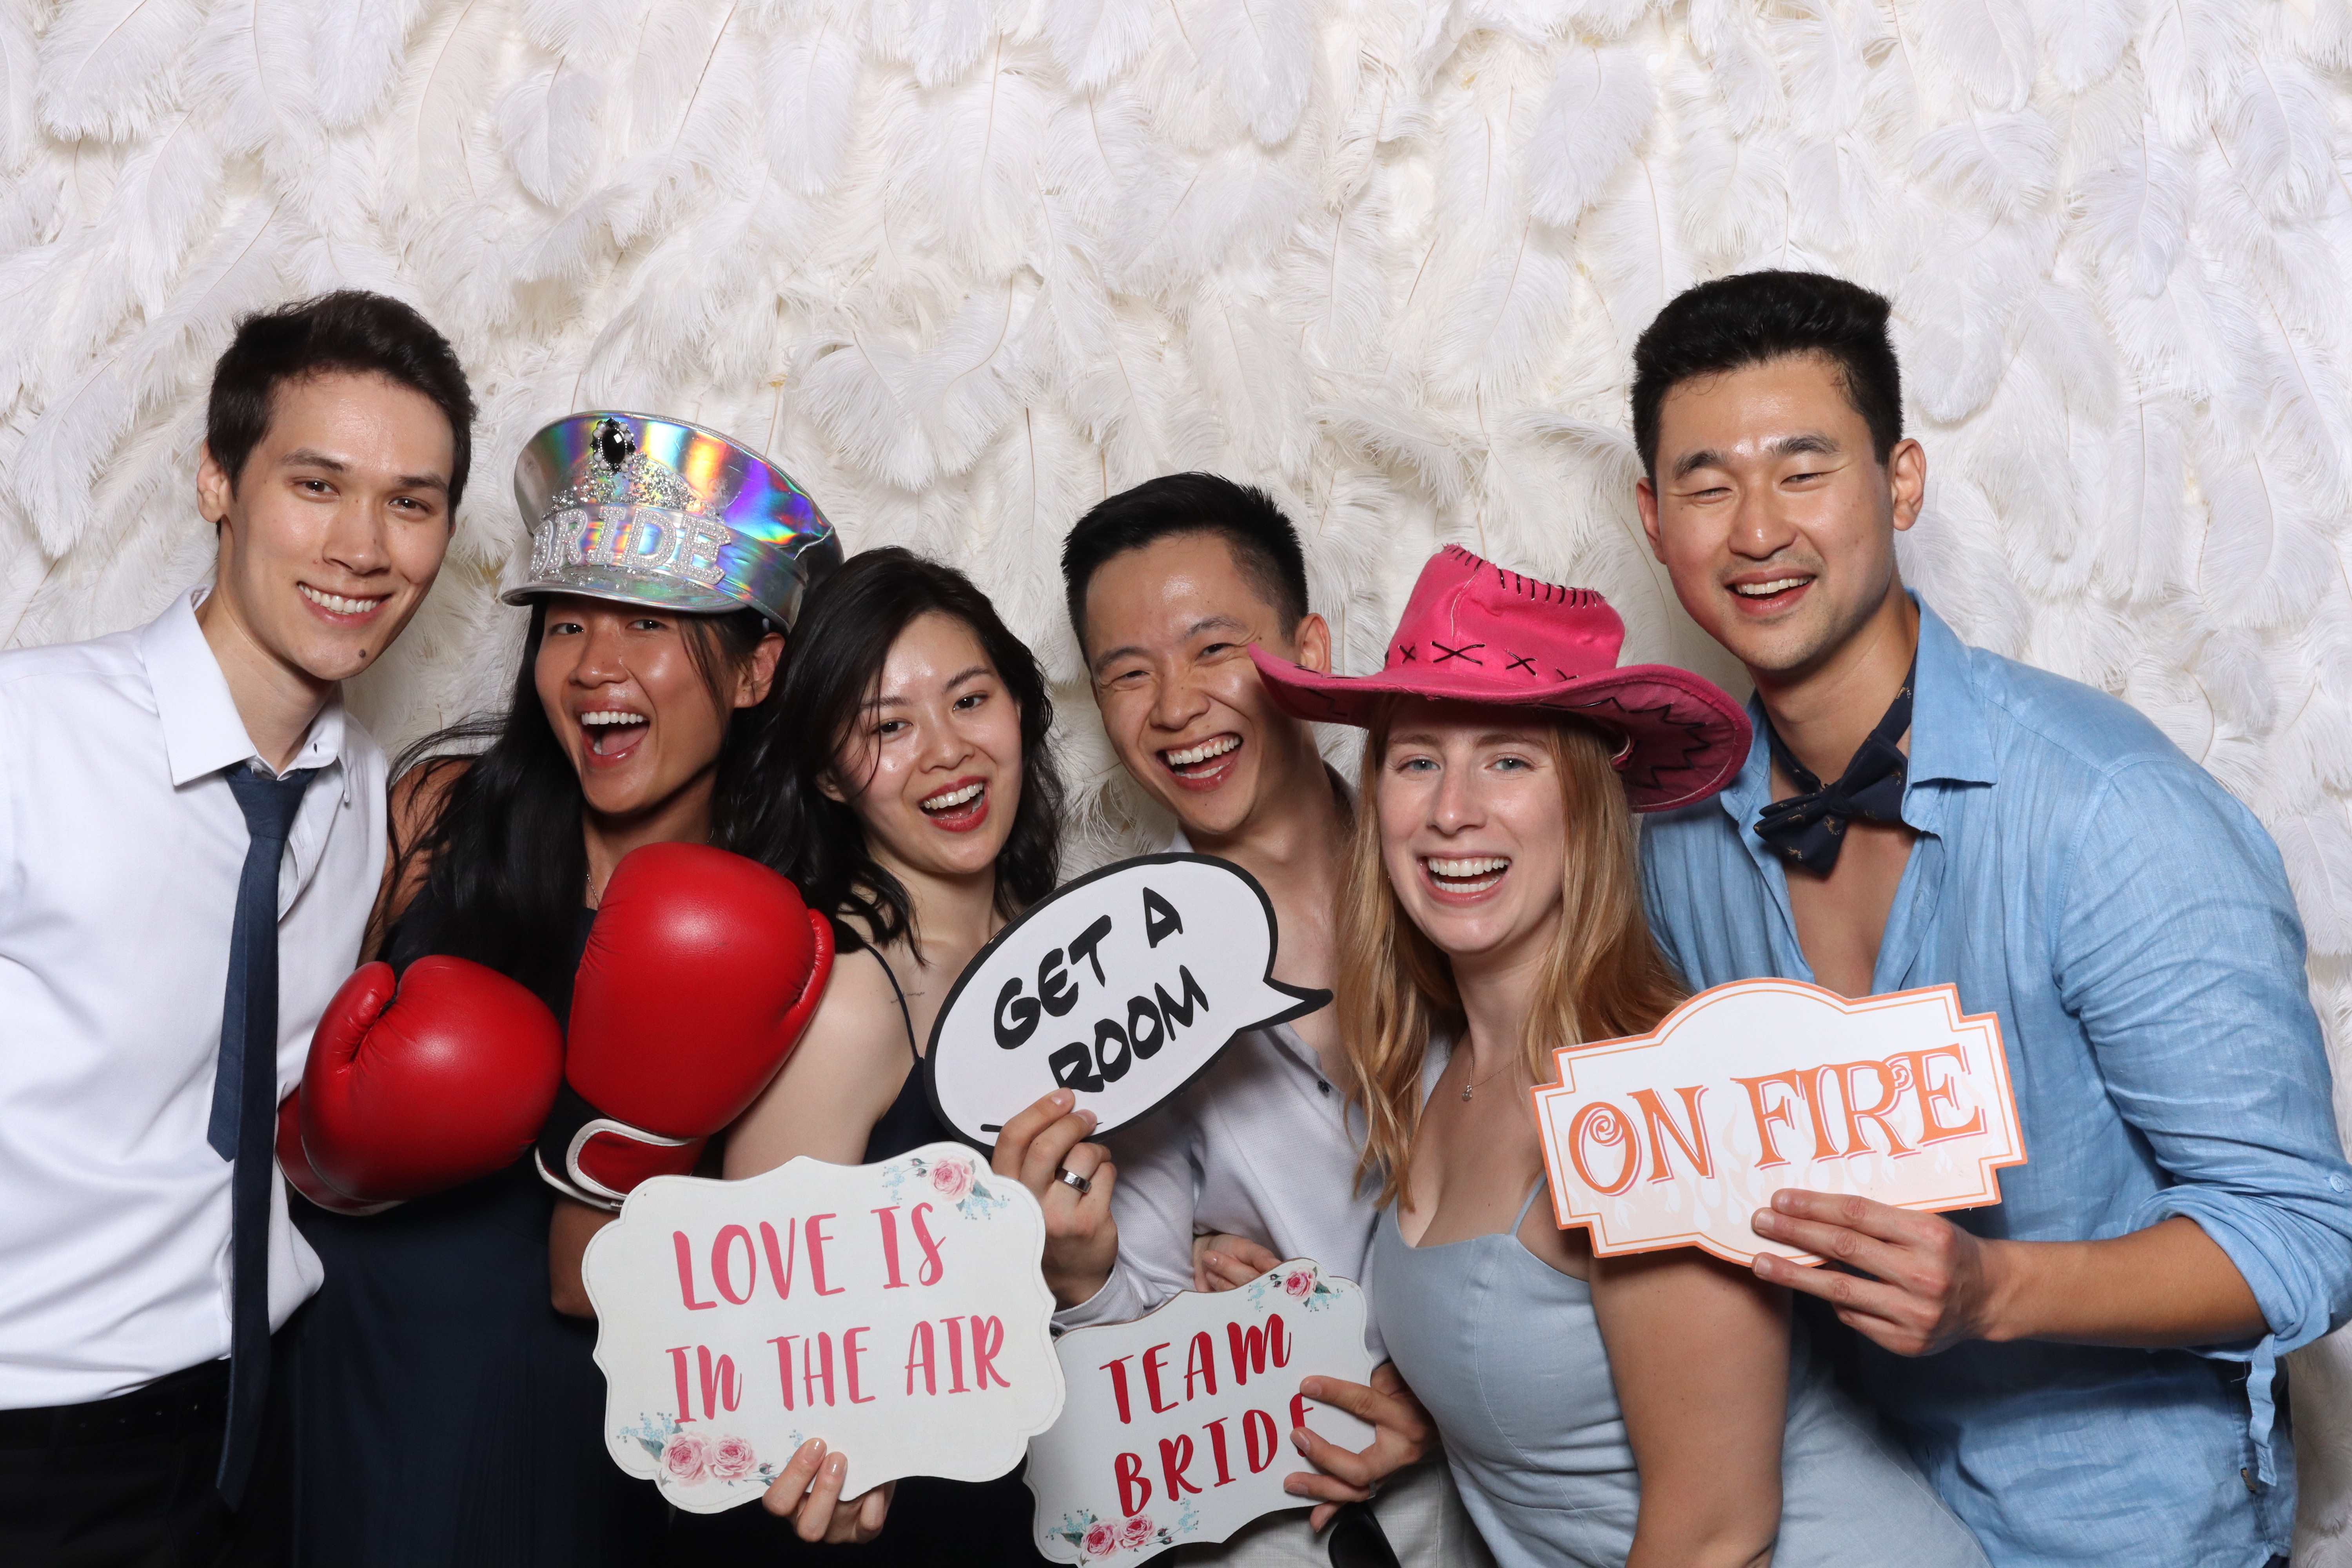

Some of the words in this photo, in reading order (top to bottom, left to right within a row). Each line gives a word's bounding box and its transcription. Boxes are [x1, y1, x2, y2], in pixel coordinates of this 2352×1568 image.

[530, 505, 731, 585] BRIDE
[994, 914, 1112, 1050] GET
[1142, 886, 1184, 949] A
[1048, 964, 1210, 1093] ROOM
[1568, 1084, 1710, 1197] ON
[1730, 1042, 1988, 1172] FIRE
[673, 1213, 846, 1311] LOVE
[871, 1202, 946, 1289] IS
[666, 1344, 742, 1424] IN
[766, 1326, 876, 1411] THE
[904, 1315, 1011, 1396] AIR
[1099, 1313, 1292, 1425] TEAM
